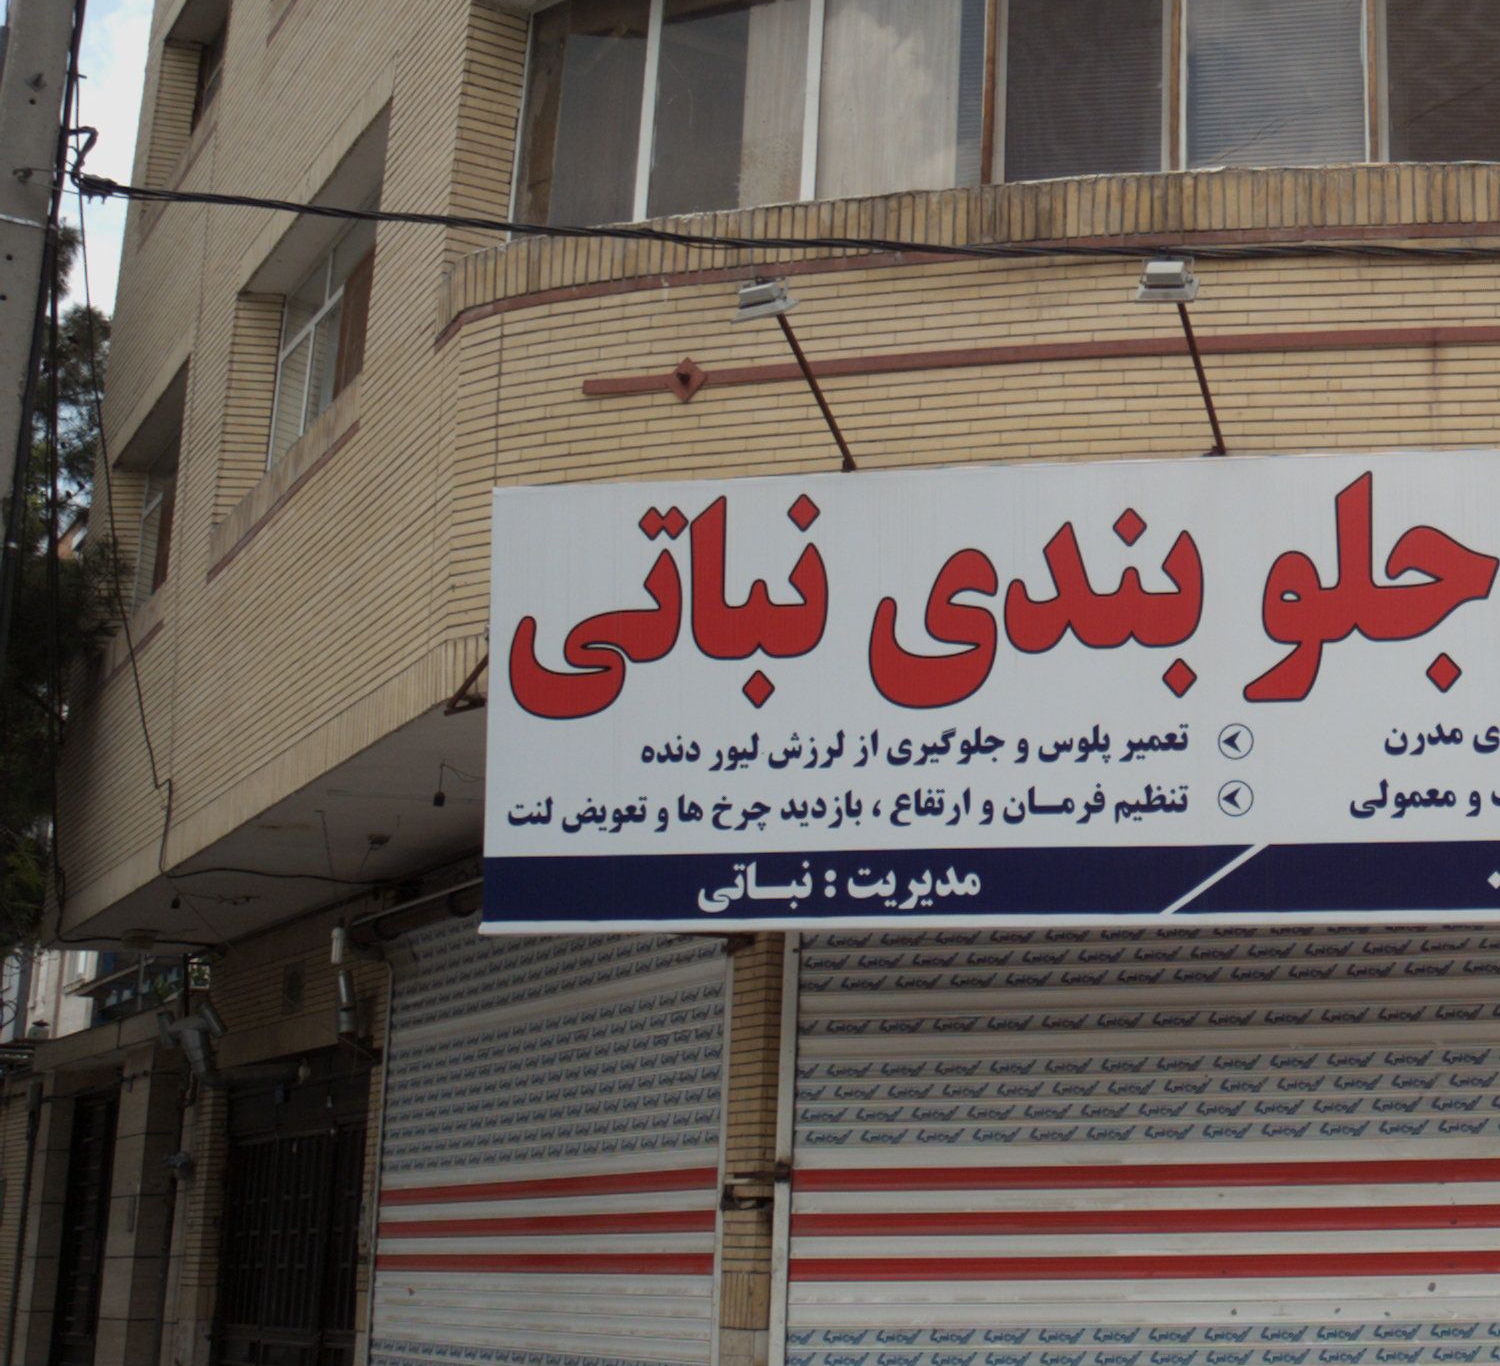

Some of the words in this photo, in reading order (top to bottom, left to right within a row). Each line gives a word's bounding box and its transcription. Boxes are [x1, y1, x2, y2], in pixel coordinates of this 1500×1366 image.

[1242, 470, 1500, 704] جلو
[508, 493, 829, 721] نباتی
[867, 507, 1205, 710] بندی
[640, 735, 701, 764] دنده
[708, 732, 760, 772] لیور
[768, 729, 845, 770] لرزش
[853, 729, 879, 768] از
[886, 726, 1006, 766] جلوگیری
[1014, 737, 1029, 764] و
[1038, 724, 1111, 764] پلوس
[1119, 723, 1189, 763] تعمیر
[1384, 723, 1464, 756] مدرن
[507, 796, 554, 827] لنت
[561, 796, 648, 834] تعویض
[677, 794, 704, 823] ها
[711, 795, 772, 831] چرخ
[780, 790, 863, 829] بازدید
[979, 799, 994, 826] و
[1002, 783, 1106, 825] فرمان
[1114, 783, 1189, 824] تنظیم
[1349, 778, 1457, 819] معمولی
[1465, 790, 1482, 817] و
[654, 807, 669, 833] و
[697, 860, 813, 913] نباتی
